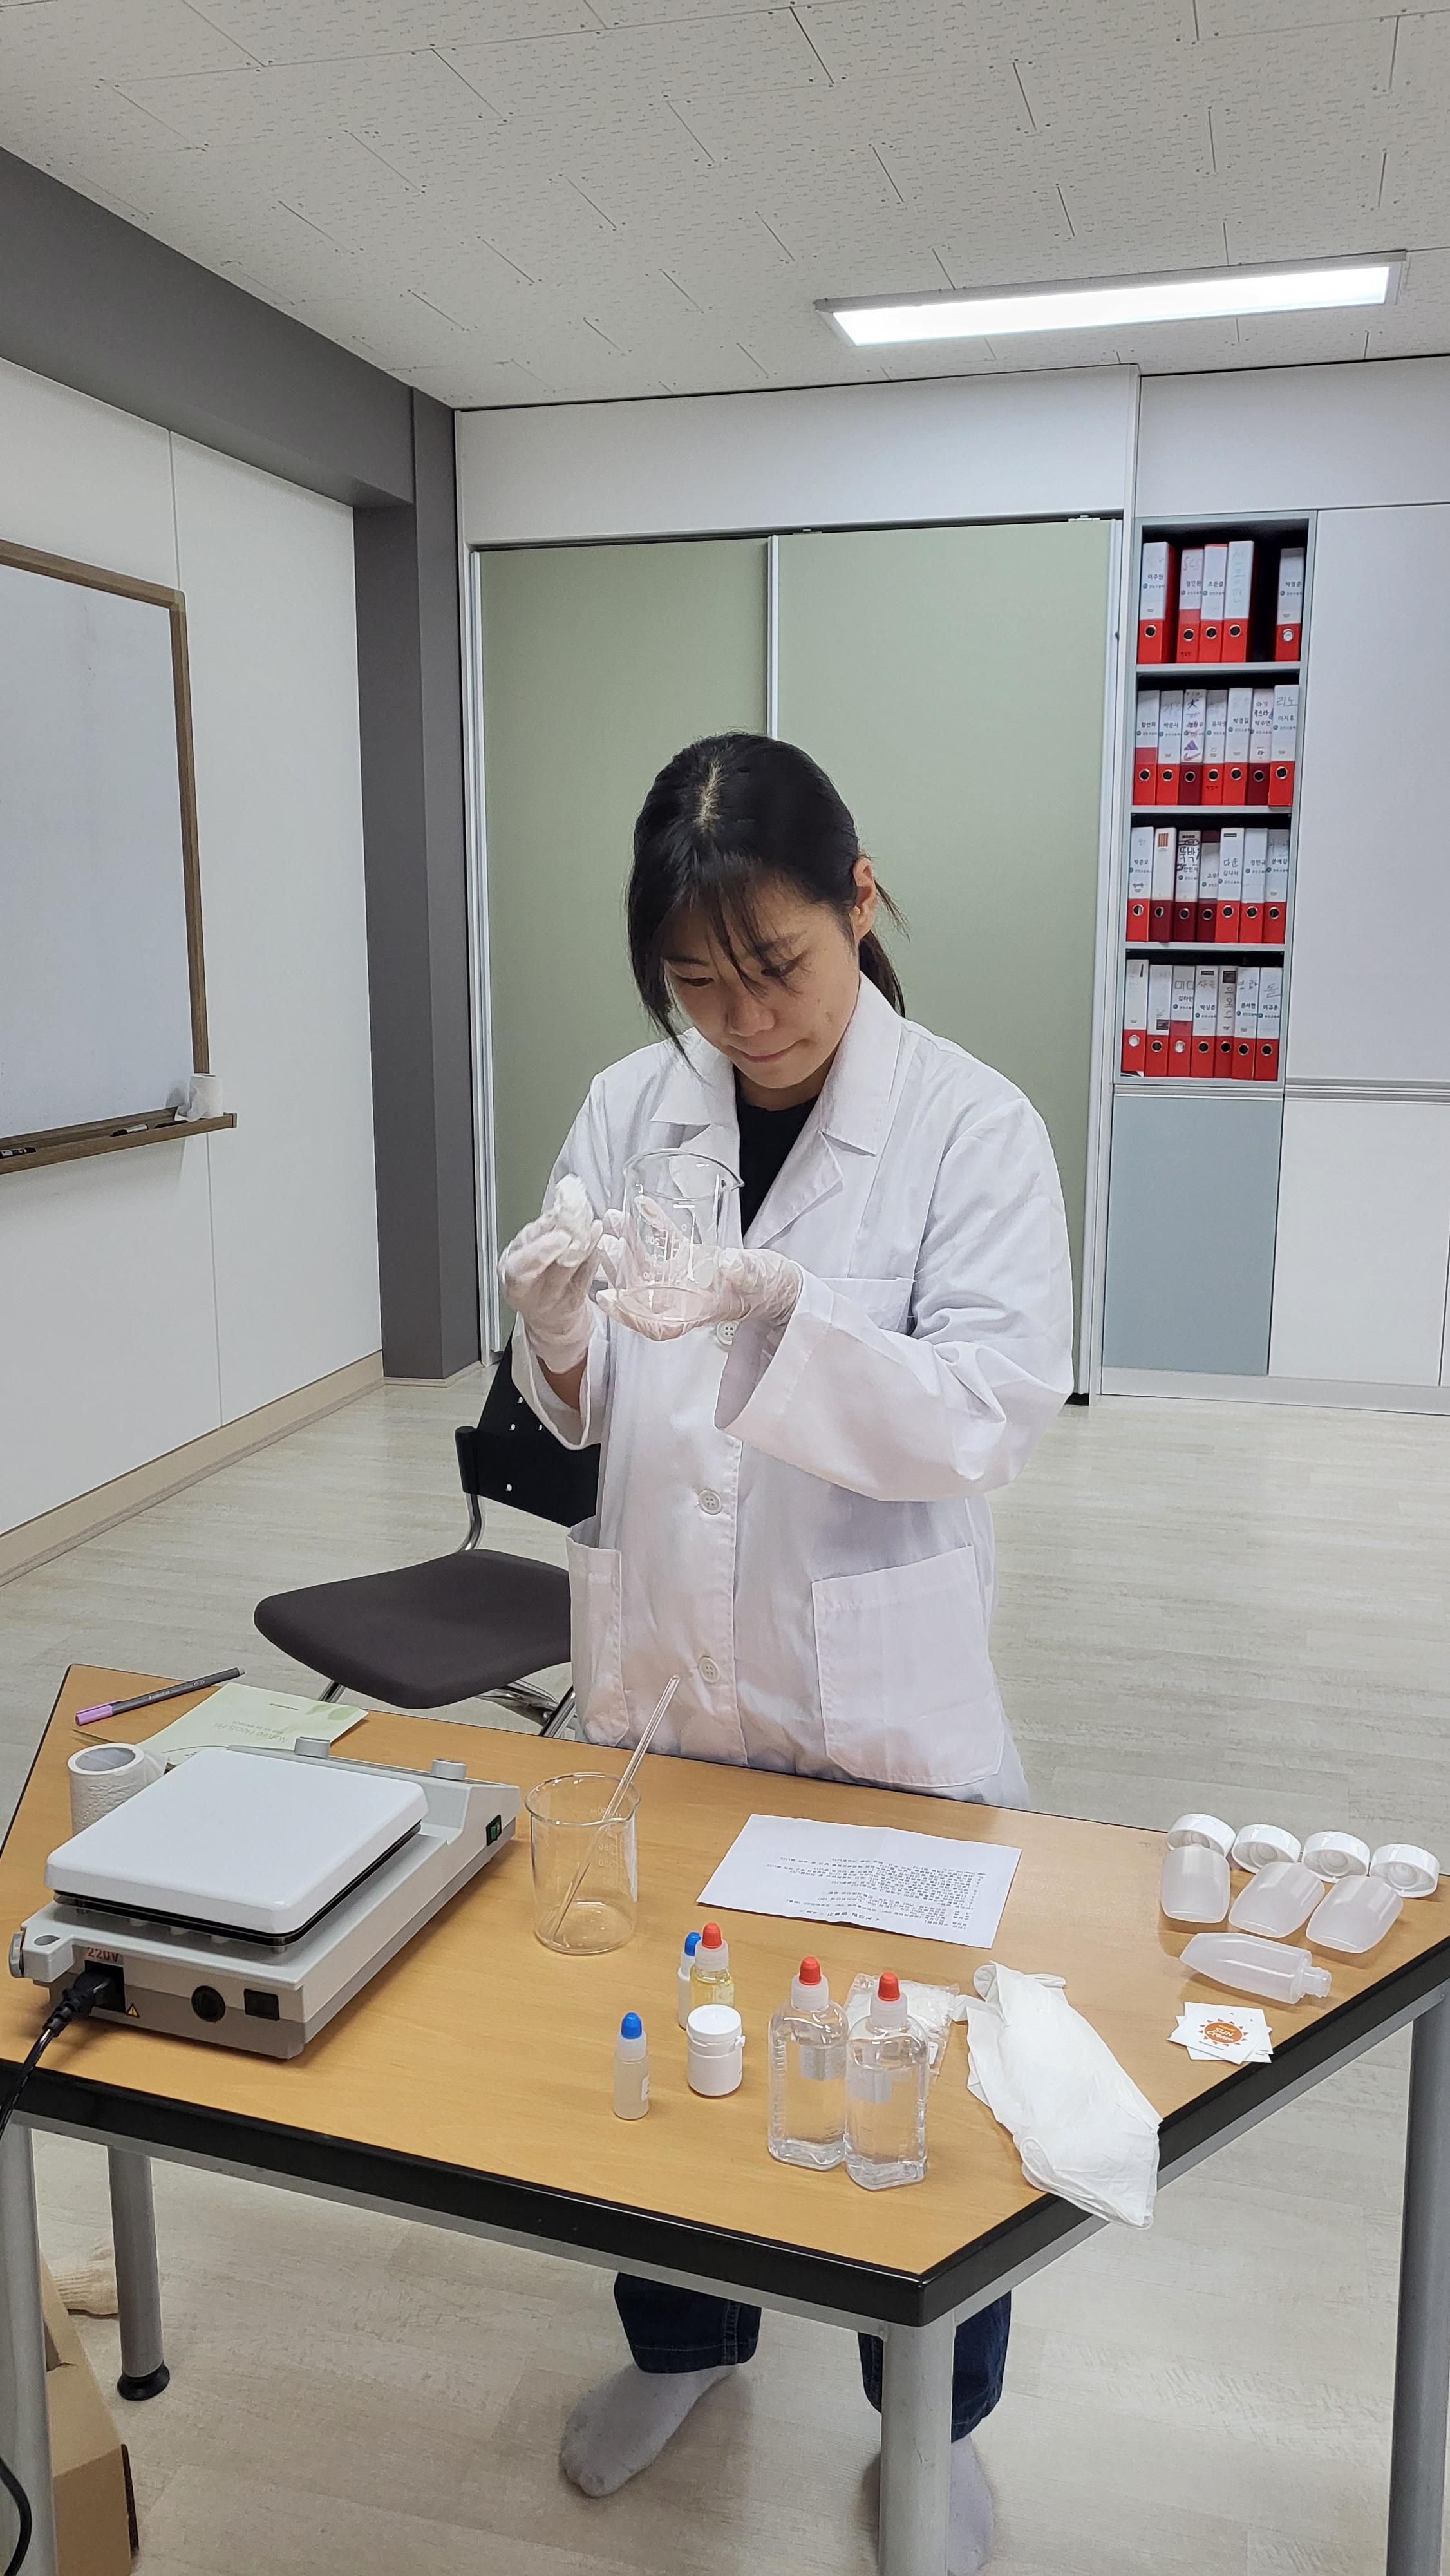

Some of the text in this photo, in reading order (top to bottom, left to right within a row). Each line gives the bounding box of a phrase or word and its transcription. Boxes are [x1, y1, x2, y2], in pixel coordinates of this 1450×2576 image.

[87, 1947, 119, 1963] 220V
[1206, 2030, 1234, 2042] Cream
[1214, 2027, 1234, 2037] SUN
